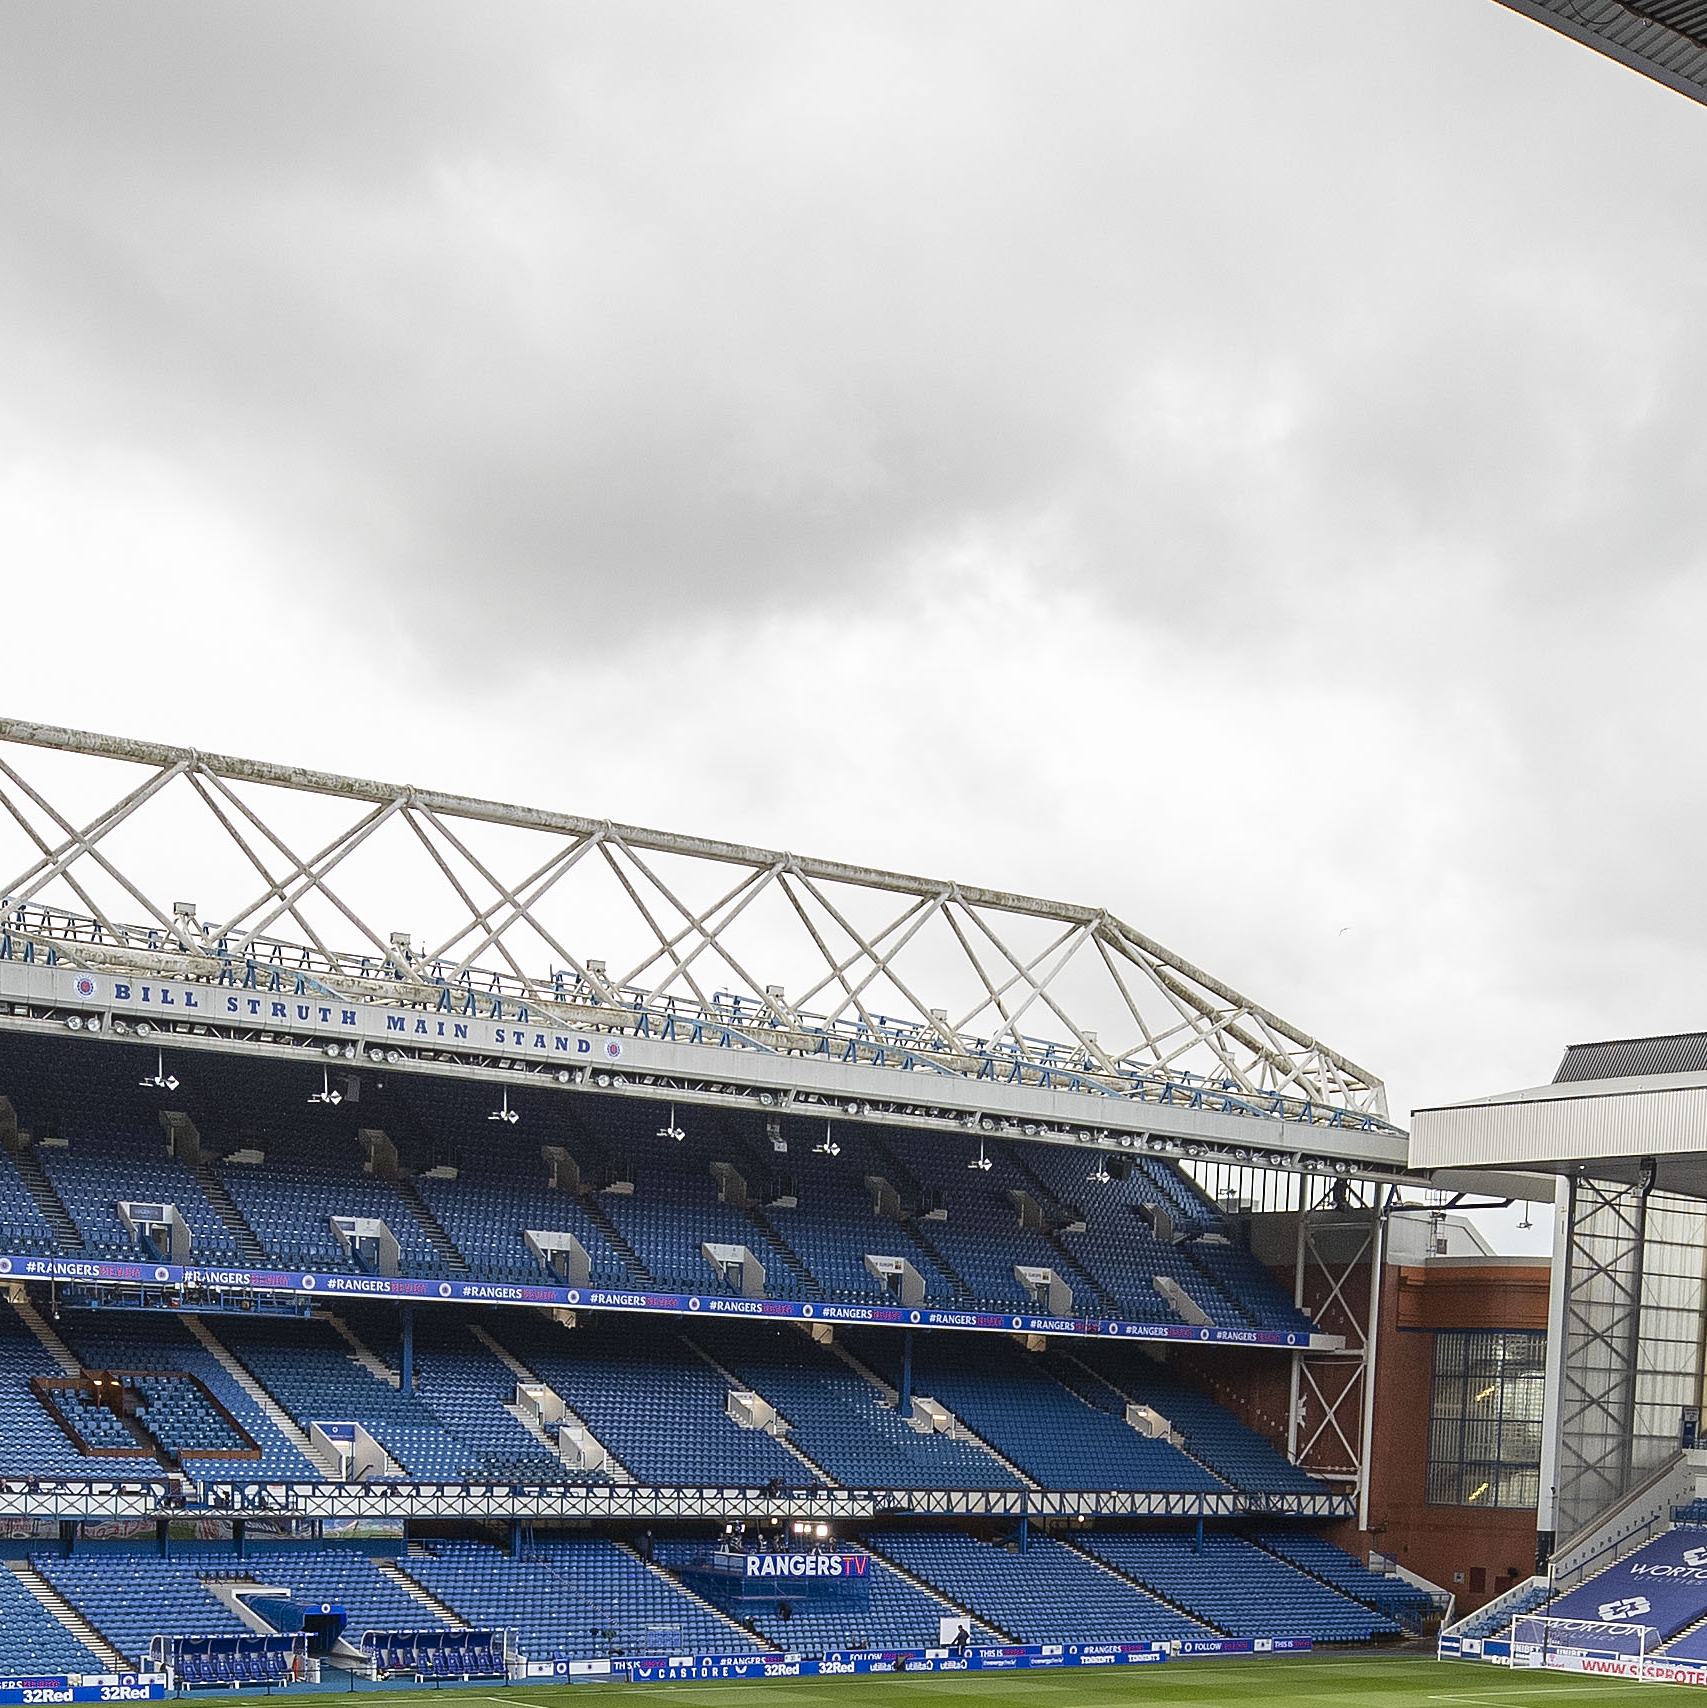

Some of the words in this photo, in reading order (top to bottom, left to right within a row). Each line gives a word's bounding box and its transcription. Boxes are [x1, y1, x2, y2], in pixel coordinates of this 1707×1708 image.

[114, 983, 199, 1008] BILL
[227, 996, 357, 1026] STRUTH
[387, 1016, 469, 1039] MAIN
[495, 1028, 592, 1053] STAND
[747, 1556, 868, 1577] RANGERSTV
[659, 1667, 729, 1678] CASTORE
[764, 1663, 799, 1676] 32Red
[818, 1662, 854, 1674] 32Red
[23, 1688, 73, 1704] 32Red
[101, 1686, 149, 1701] 32Red
